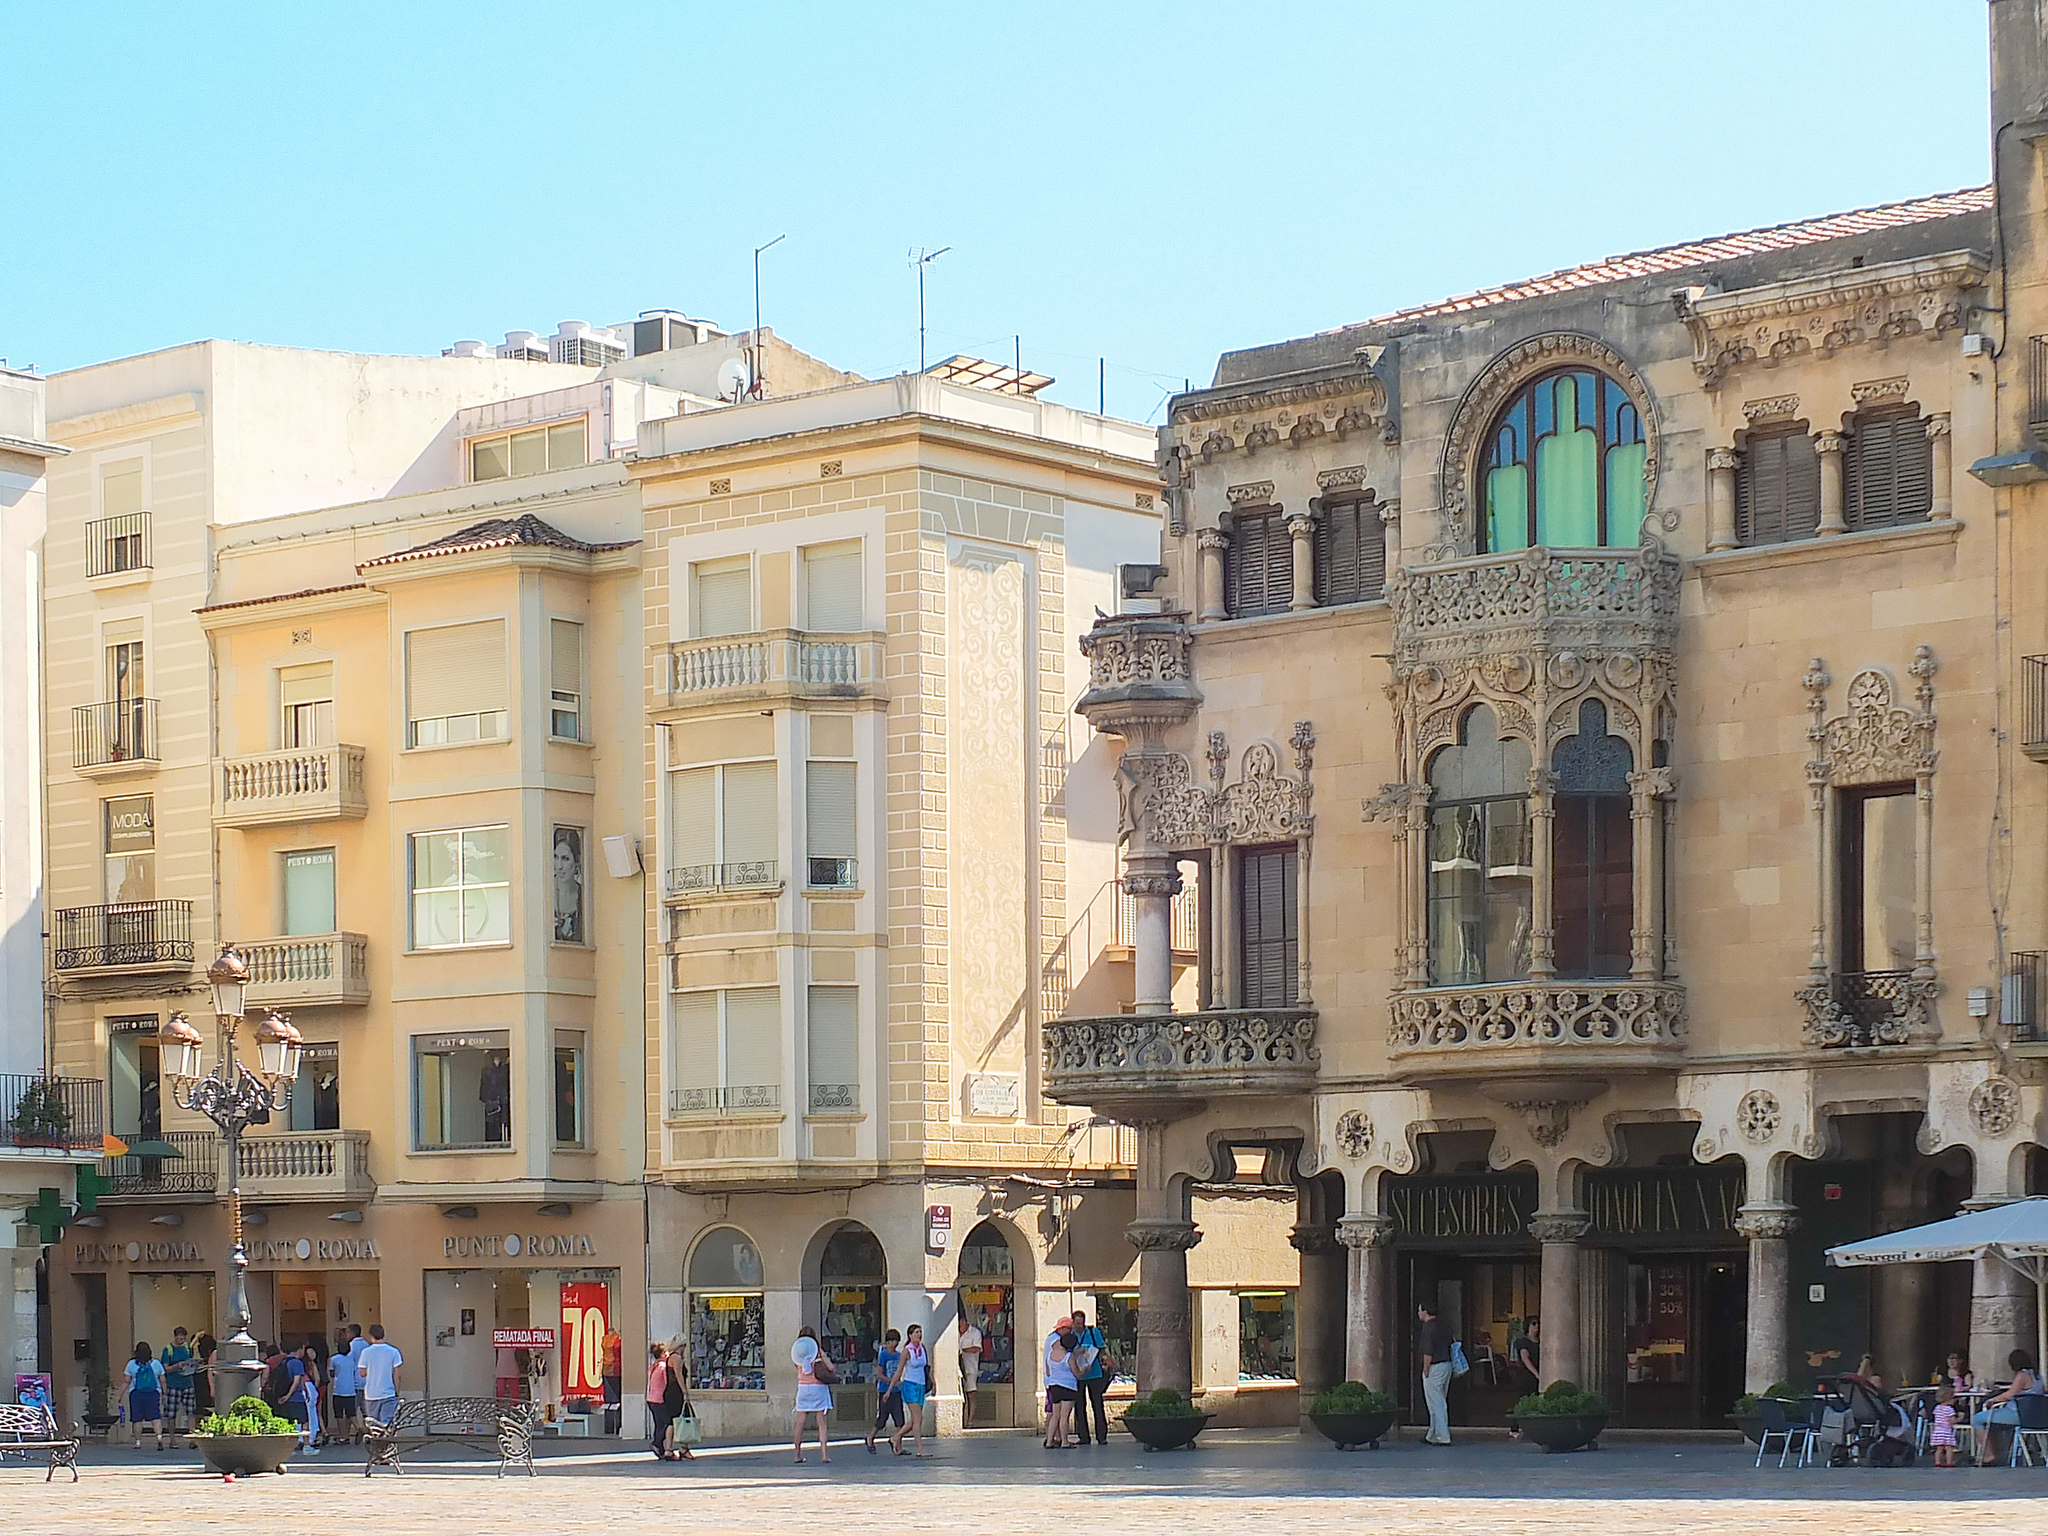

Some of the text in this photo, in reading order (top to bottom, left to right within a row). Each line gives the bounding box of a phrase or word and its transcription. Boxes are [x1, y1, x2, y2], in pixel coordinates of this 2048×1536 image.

[112, 812, 151, 829] MODA
[1391, 1185, 1522, 1237] SUCESORES
[145, 1241, 204, 1261] ROMA
[316, 1239, 379, 1260] ROMA
[526, 1234, 597, 1256] ROMA
[1855, 1250, 1907, 1263] Farggi
[1659, 1301, 1684, 1314] 50%
[493, 1330, 554, 1342] REMATADA FINAL
[562, 1306, 606, 1389] 70
